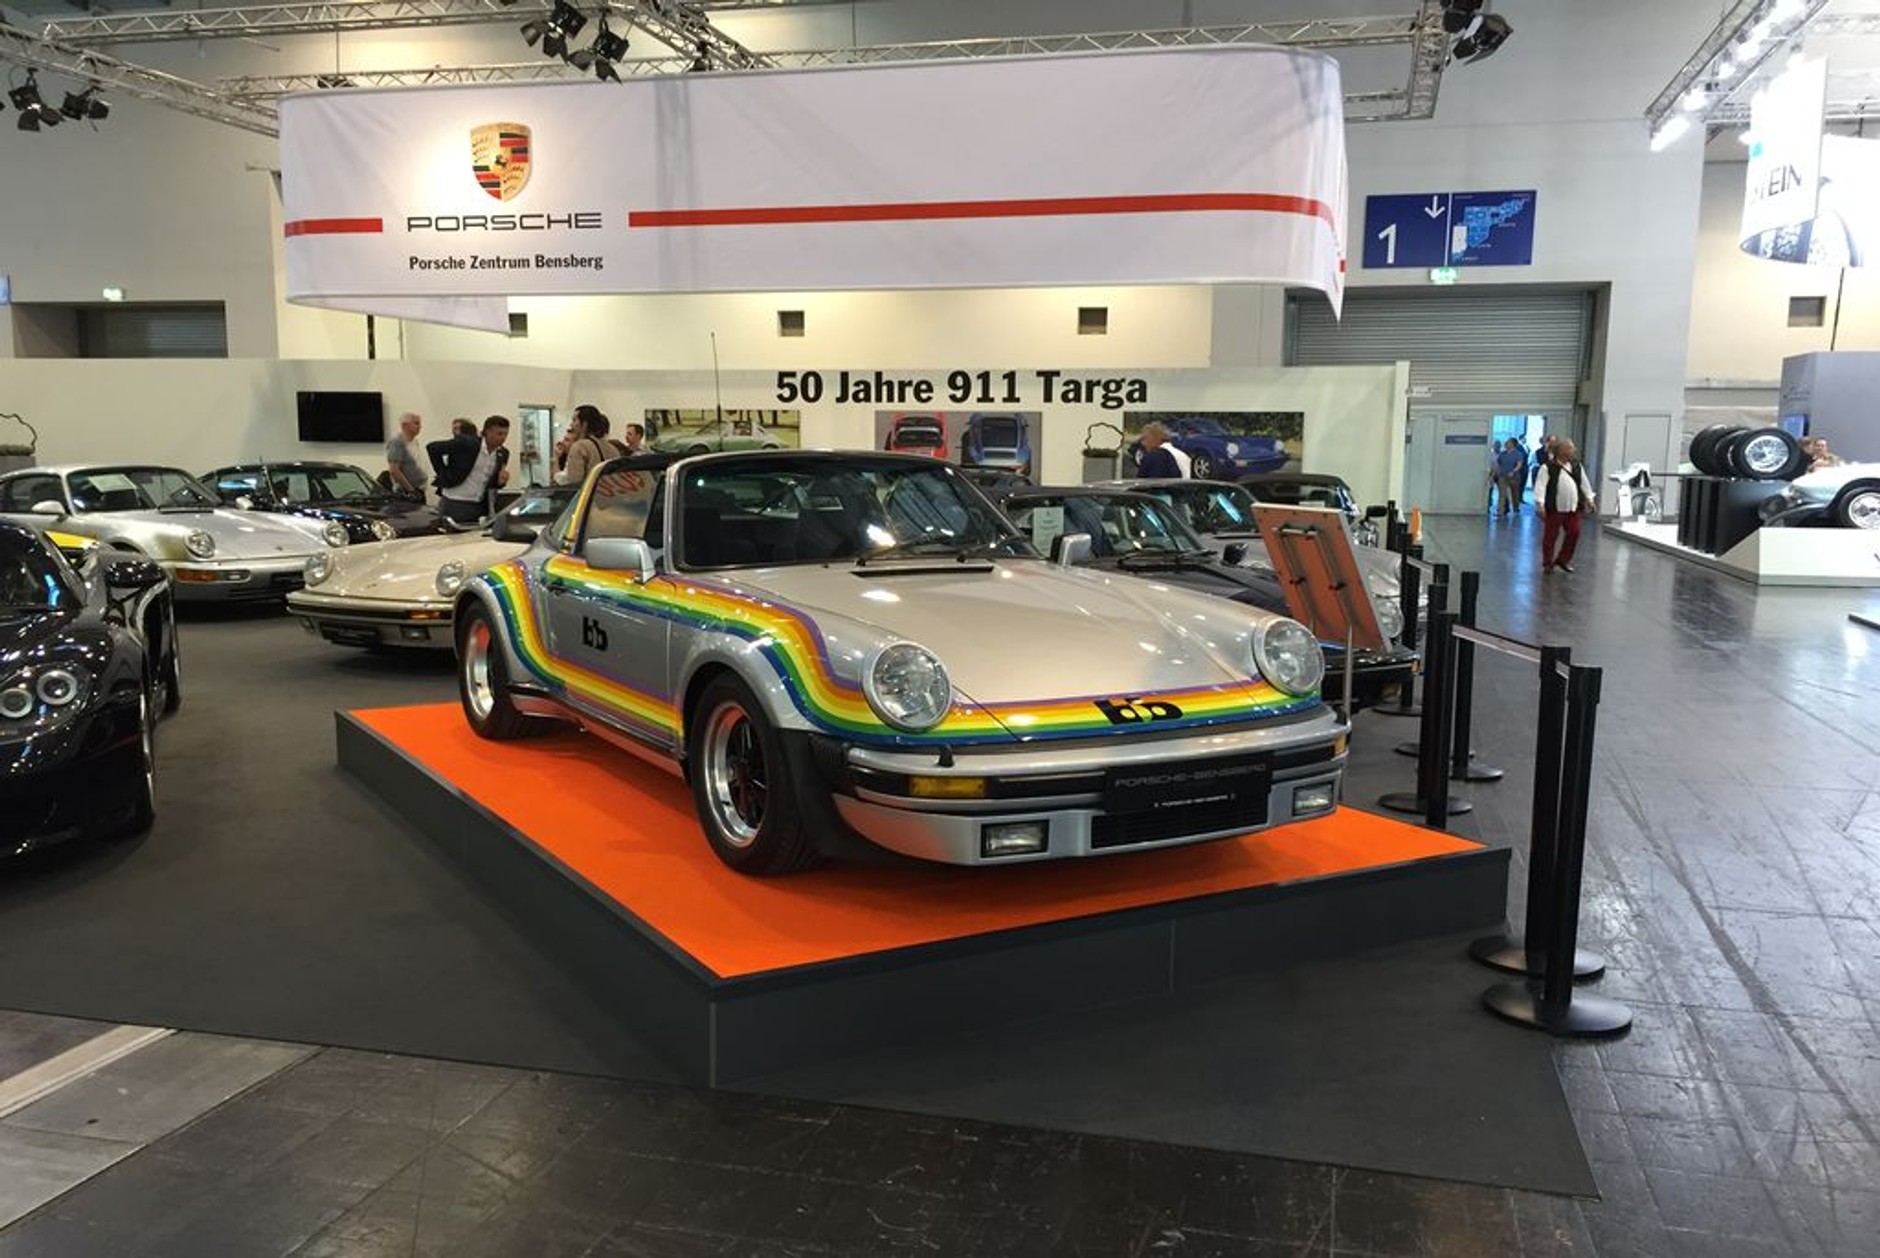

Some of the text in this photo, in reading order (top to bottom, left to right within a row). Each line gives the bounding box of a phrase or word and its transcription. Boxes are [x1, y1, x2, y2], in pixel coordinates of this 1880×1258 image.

[407, 213, 602, 232] PORSCHE
[1378, 223, 1397, 265] 1
[409, 253, 604, 271] Porsche Zentrum Bensberg
[776, 369, 1148, 410] 50 Jahre 911 Targa
